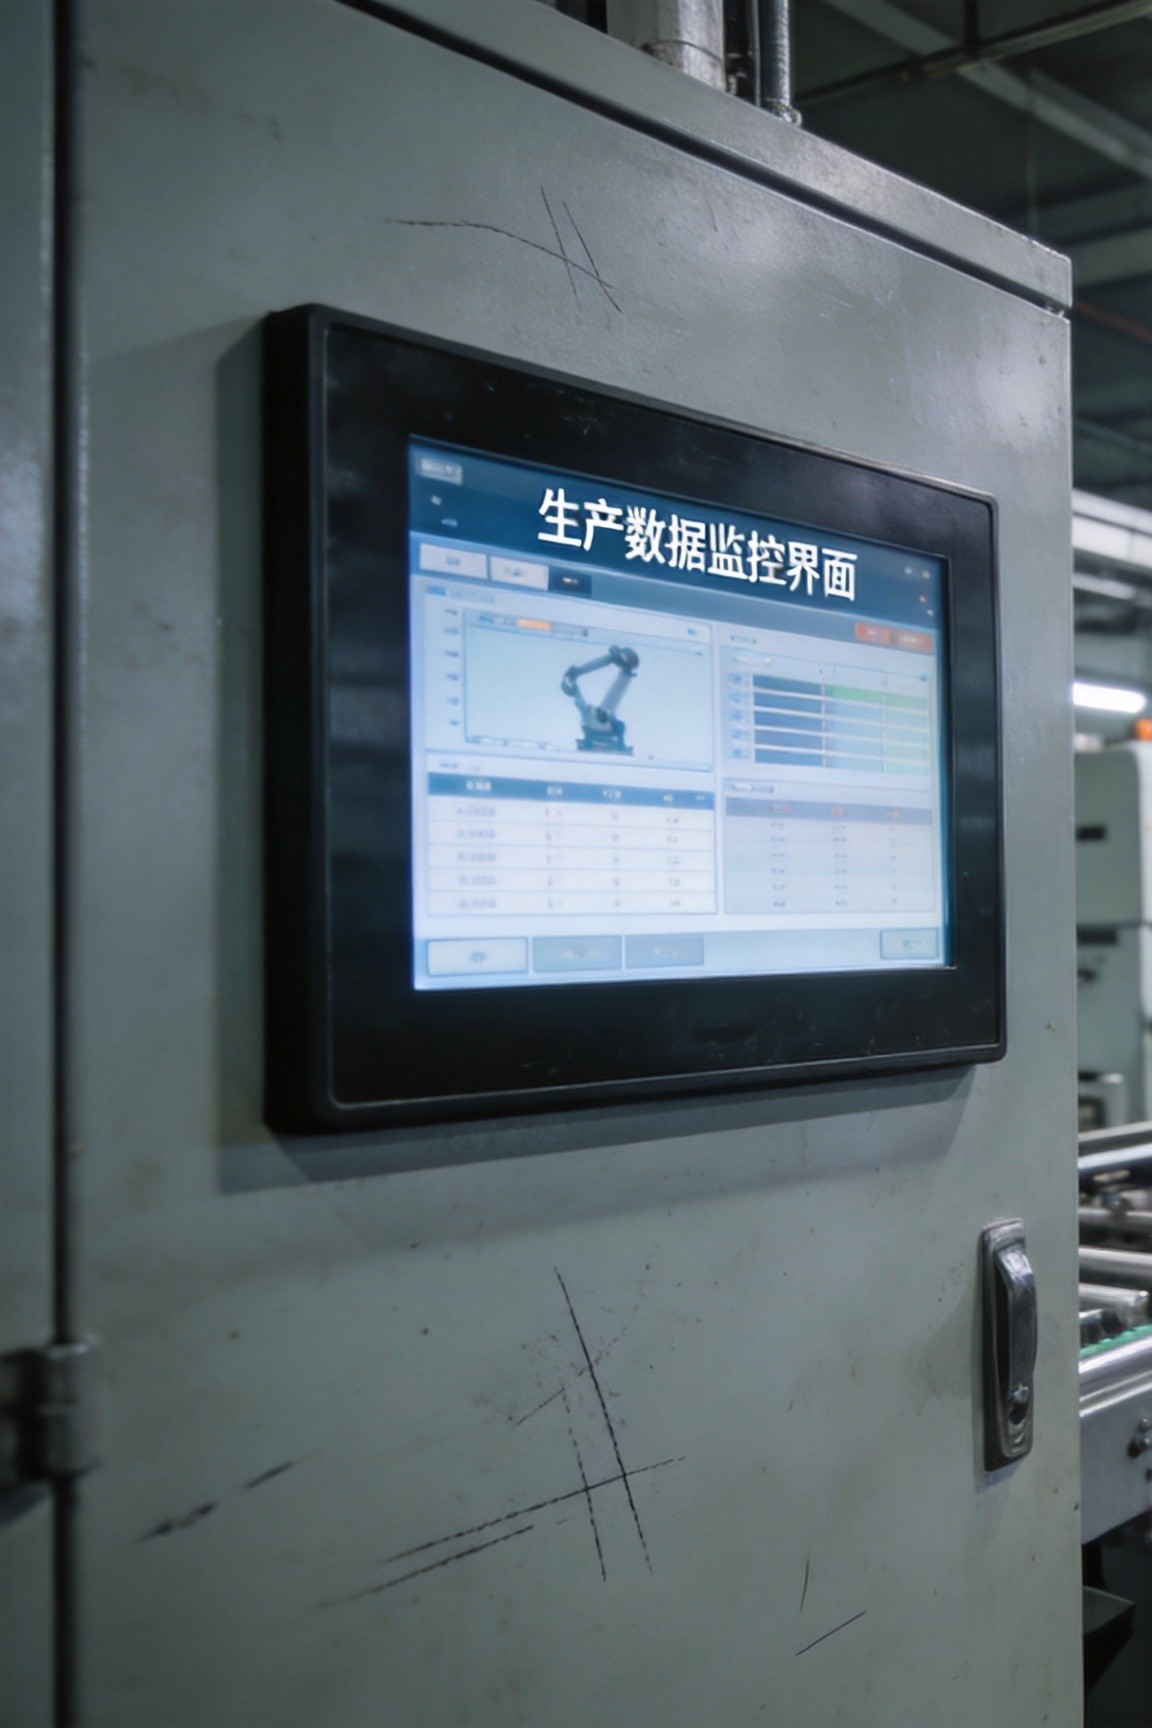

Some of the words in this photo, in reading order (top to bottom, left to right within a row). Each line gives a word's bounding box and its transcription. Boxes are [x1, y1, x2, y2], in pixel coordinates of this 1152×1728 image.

[537, 488, 858, 601] 生产数据监控界面
